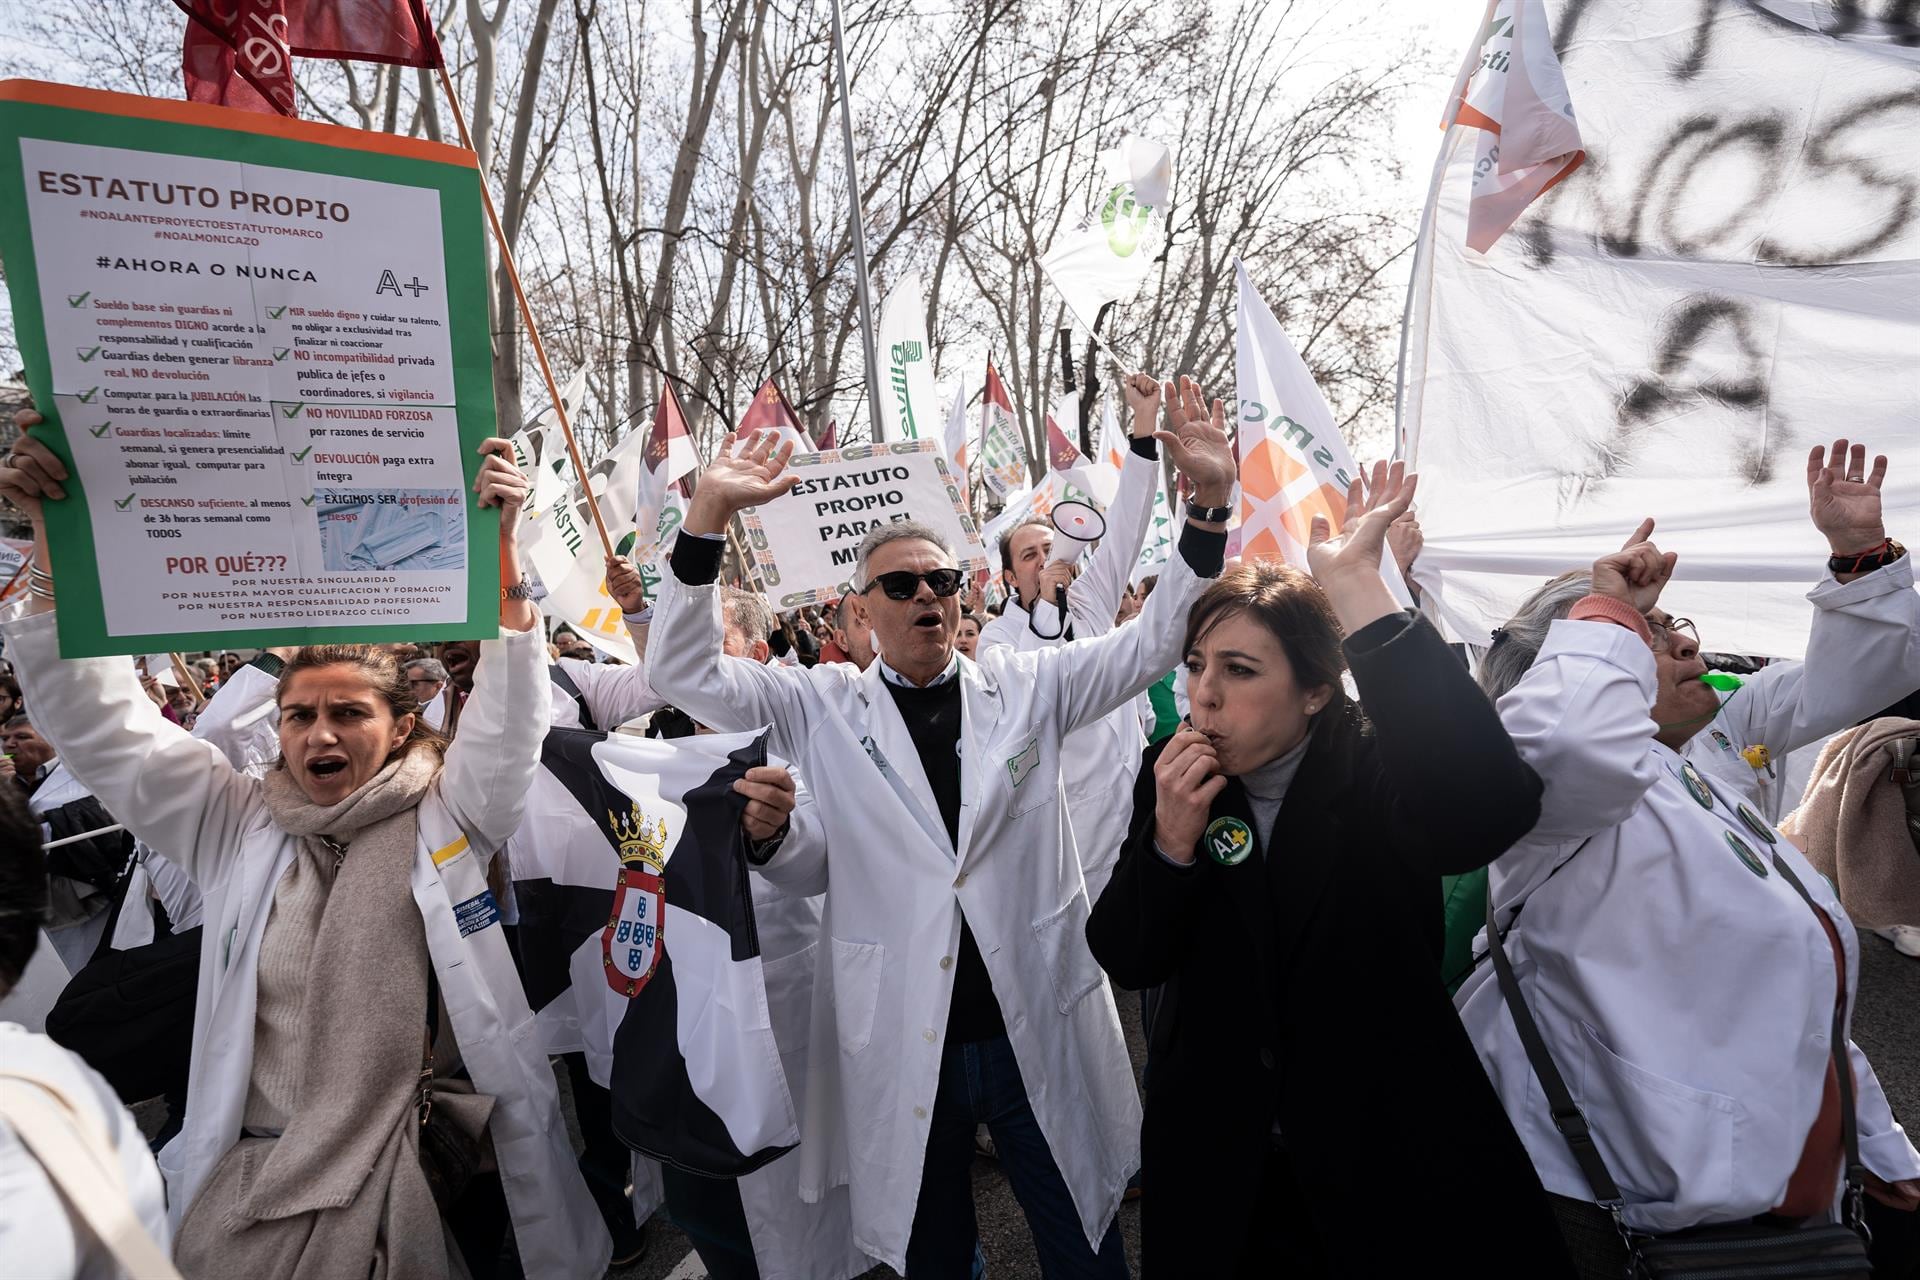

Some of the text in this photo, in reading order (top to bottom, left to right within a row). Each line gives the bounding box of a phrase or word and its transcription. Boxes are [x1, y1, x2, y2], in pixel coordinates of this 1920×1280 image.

[38, 171, 349, 222] ESTATUTO PROPIO
[79, 209, 324, 240] #NOALANTEPROYECTOESTATUTOMARCO
[154, 231, 259, 246] #NOALMONICAZO
[96, 255, 317, 283] #AHORA O NUNCA
[376, 270, 429, 297] A+
[94, 300, 232, 317] Sueldo base sin guardias ni
[289, 307, 305, 316] MIR
[308, 309, 334, 318] sueldo
[337, 310, 360, 320] digno
[363, 314, 367, 322] y
[371, 313, 395, 322] cuidar
[96, 317, 172, 329] complementos
[175, 321, 208, 331] DIGNO
[212, 323, 245, 333] acorde
[257, 325, 266, 334] la
[305, 324, 332, 334] obligar
[343, 326, 393, 336] exclusividad
[396, 329, 412, 337] tras
[99, 334, 253, 349] responsabilidad y cualificación
[294, 337, 383, 348] finalizar ni coaccionar
[102, 351, 273, 366] Guardias deben generar libranza
[294, 350, 435, 367] NO incompatibilidad privada
[132, 368, 148, 378] NO
[152, 369, 209, 381] devolución
[297, 370, 333, 382] publica
[337, 370, 348, 380] de
[351, 370, 375, 382] jefes
[1612, 290, 1793, 486] A
[104, 389, 261, 403] Computar para la JUBILACIÓN las
[377, 390, 385, 399] si
[388, 390, 434, 401] vigilancia
[107, 405, 135, 415] horas
[139, 406, 150, 415] de
[153, 407, 189, 417] guardia
[201, 409, 270, 418] extraordinarias
[307, 408, 433, 421] NO MOVILIDAD FORZOSA
[116, 427, 160, 438] Guardias
[310, 428, 424, 438] por razones de servicio
[169, 445, 178, 453] si
[180, 446, 214, 454] genera
[218, 445, 285, 455] presencialidad
[125, 460, 159, 469] abonar
[196, 461, 241, 471] computar
[244, 462, 265, 471] para
[314, 452, 434, 466] DEVOLUCIÓN paga extra
[129, 475, 177, 486] jubilación
[317, 471, 352, 482] íntegra
[790, 466, 909, 496] ESTATUTO
[141, 499, 195, 508] DESCANSO
[250, 499, 258, 508] al
[325, 494, 459, 506] EXIGIMOS SER profesión de
[815, 490, 904, 517] PROPIO
[144, 514, 156, 523] de
[158, 514, 171, 523] 36
[174, 514, 200, 523] horas
[204, 514, 243, 523] semanal
[327, 513, 357, 523] riesgo
[146, 529, 182, 538] TODOS
[166, 551, 287, 576] POR QUÉ???
[317, 576, 396, 584] SINGULARIDAD
[193, 591, 248, 599] NUESTRA
[209, 601, 263, 609] NUESTRA
[267, 598, 370, 608] RESPONSABILIDAD
[250, 611, 303, 619] NUESTRO
